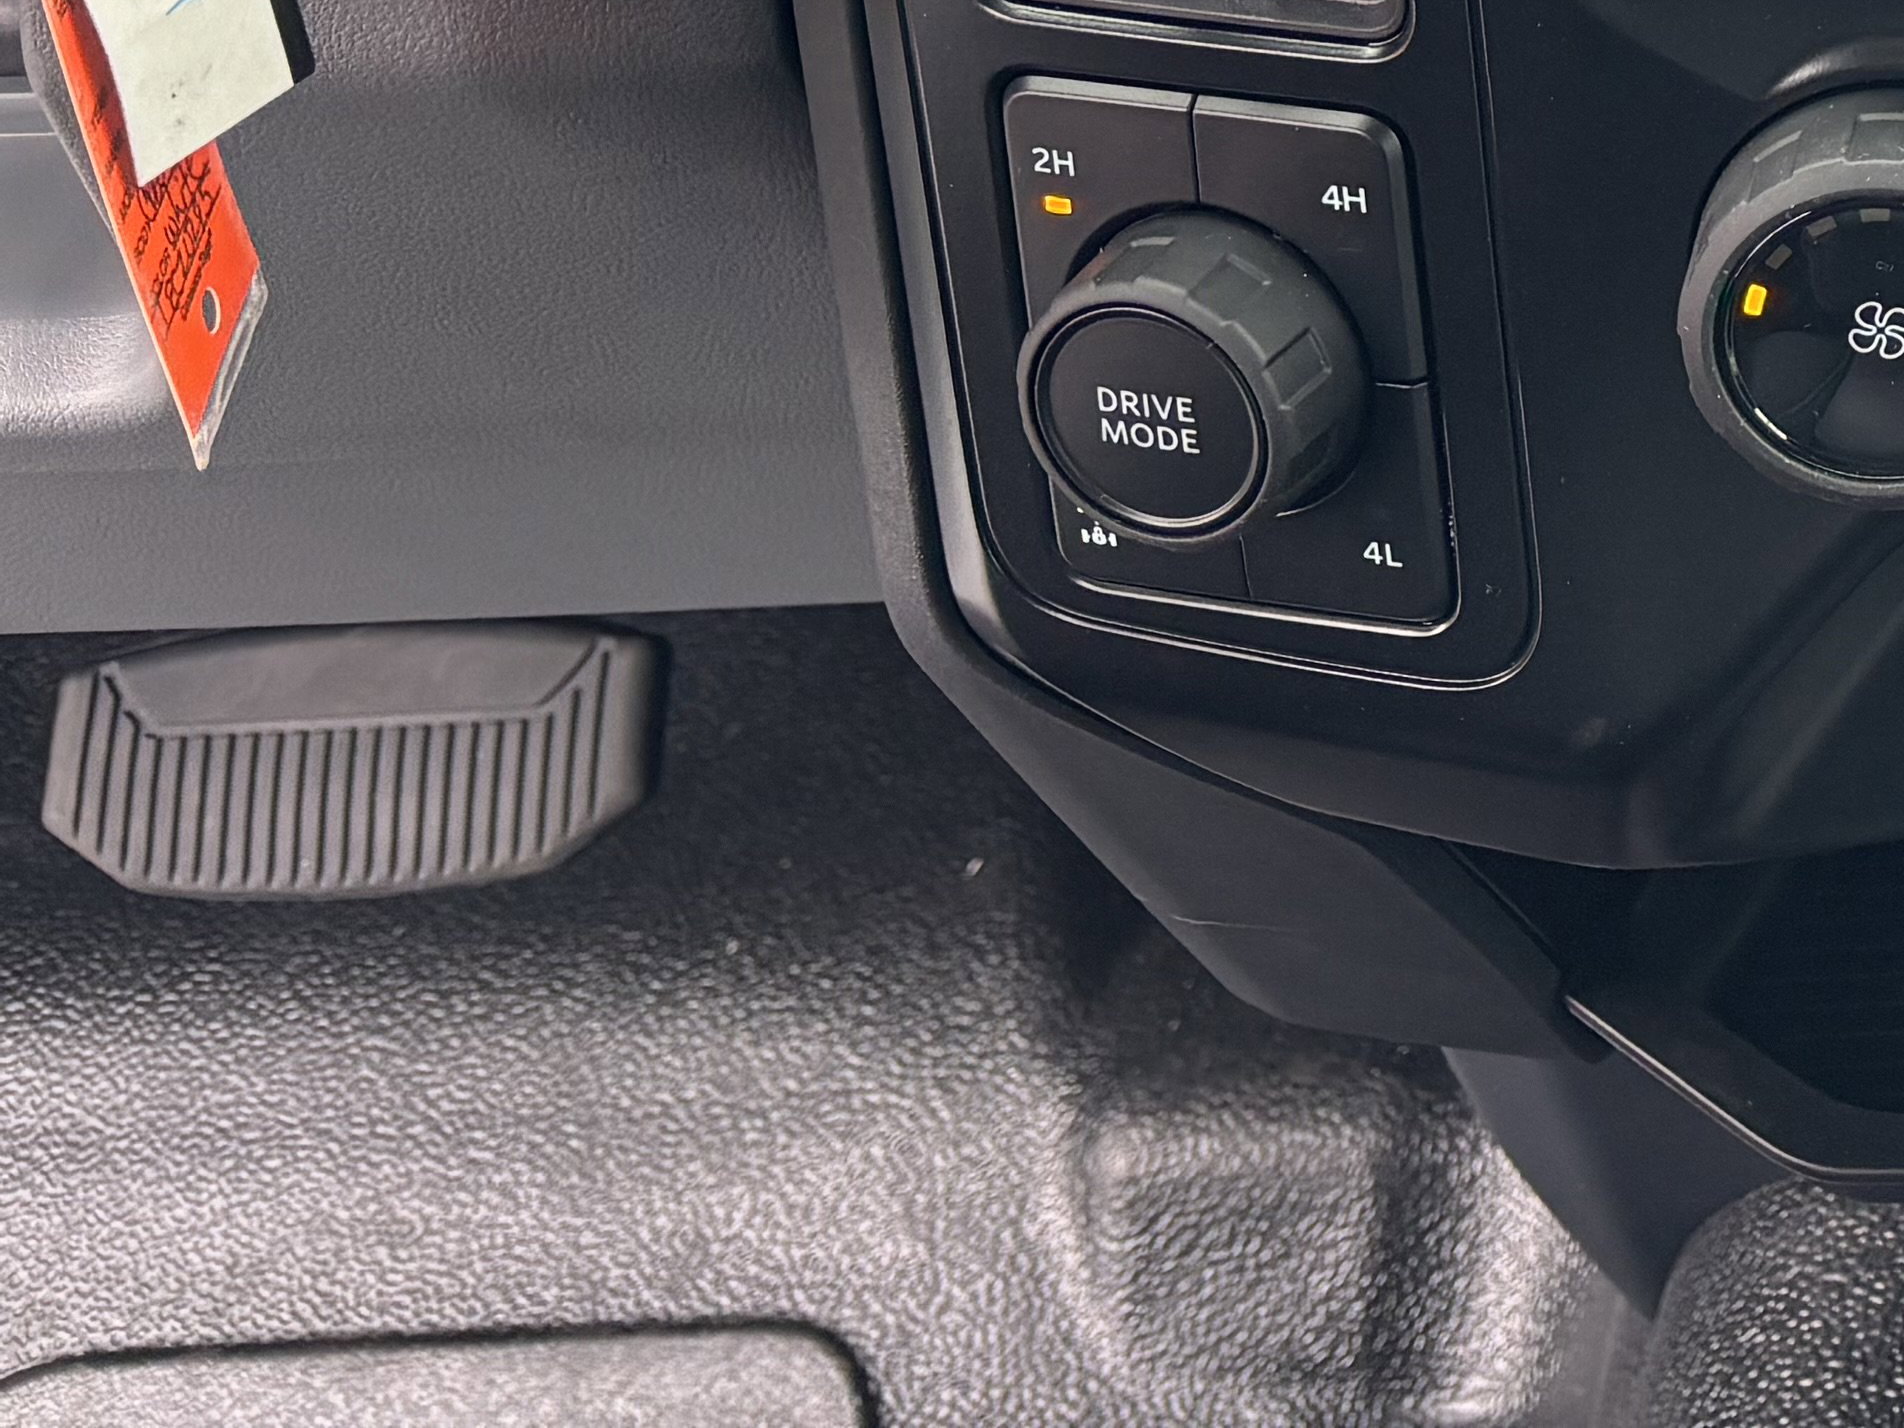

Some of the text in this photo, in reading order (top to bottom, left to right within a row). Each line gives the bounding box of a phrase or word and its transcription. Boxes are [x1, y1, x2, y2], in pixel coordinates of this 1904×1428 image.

[1032, 147, 1075, 177] 2H
[1321, 185, 1367, 214] 4H
[1096, 386, 1196, 423] DRIVE
[1101, 417, 1201, 454] MODE
[1363, 541, 1403, 568] 4L
